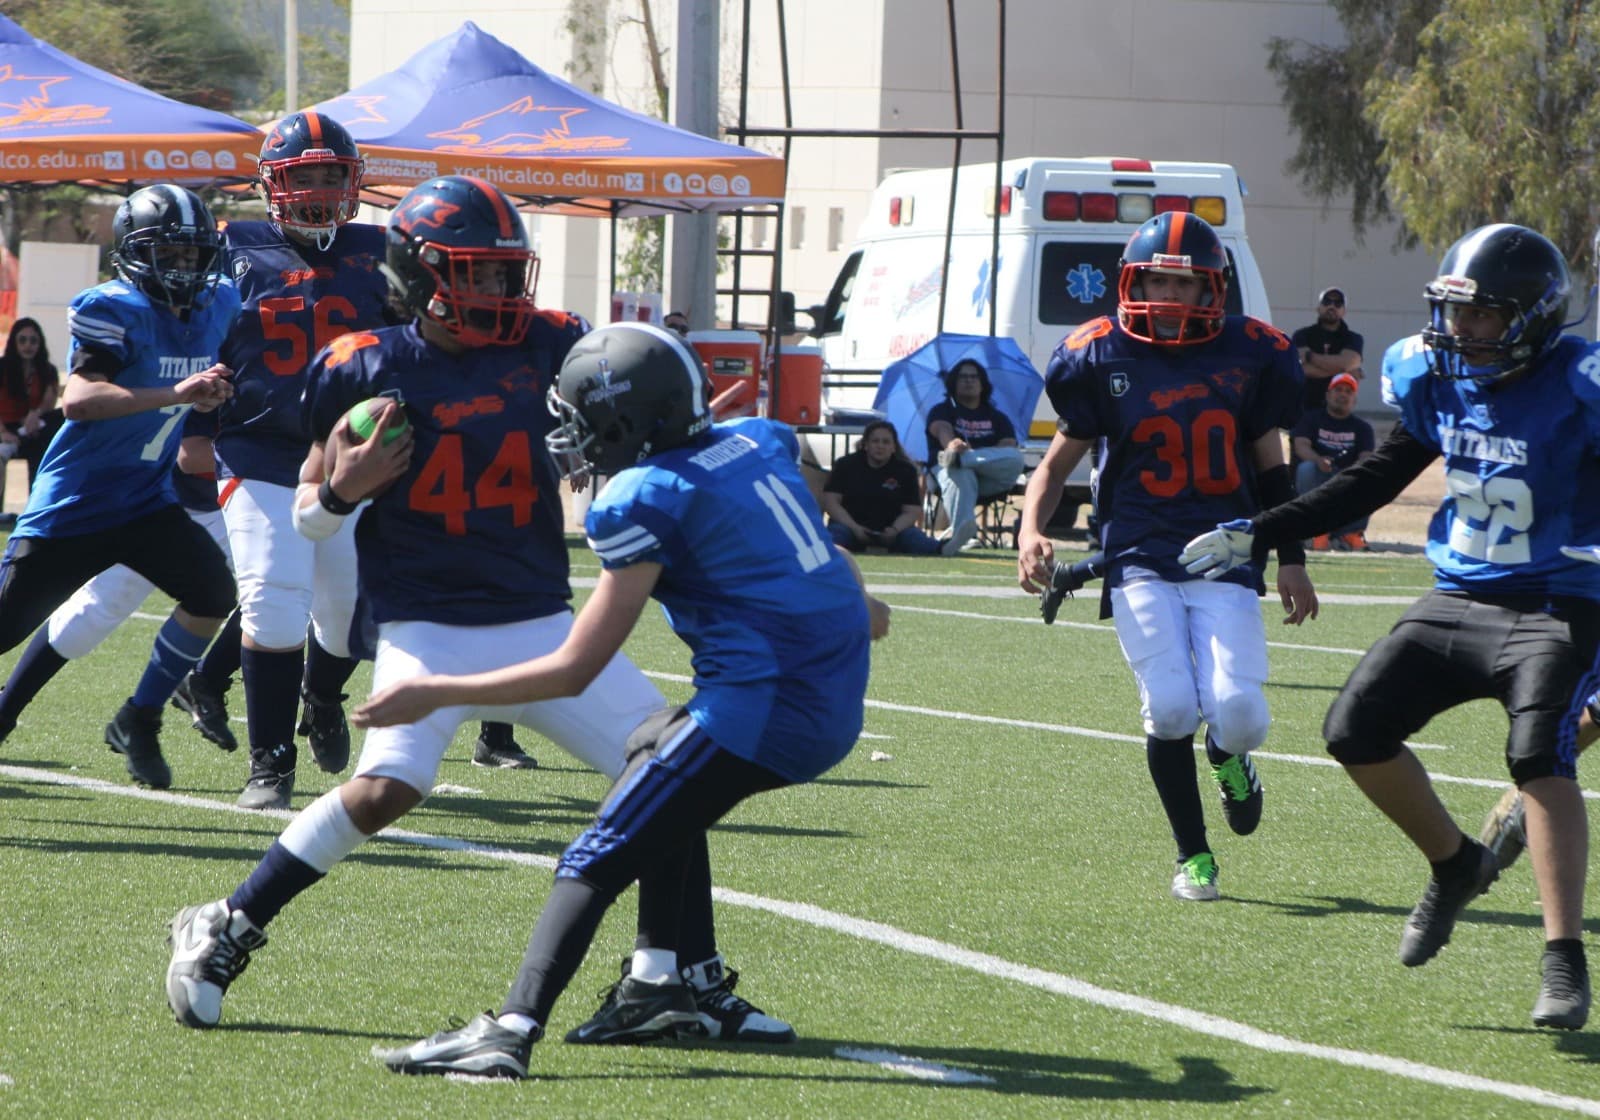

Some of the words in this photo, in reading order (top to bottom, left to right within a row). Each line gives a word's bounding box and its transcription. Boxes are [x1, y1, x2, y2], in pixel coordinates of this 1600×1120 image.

[259, 295, 357, 376] 56
[141, 402, 196, 461] 7
[1132, 409, 1241, 497] 30
[1438, 424, 1528, 465] TITANES
[409, 430, 539, 535] 44
[752, 473, 831, 573] 11
[1446, 468, 1534, 563] 22
